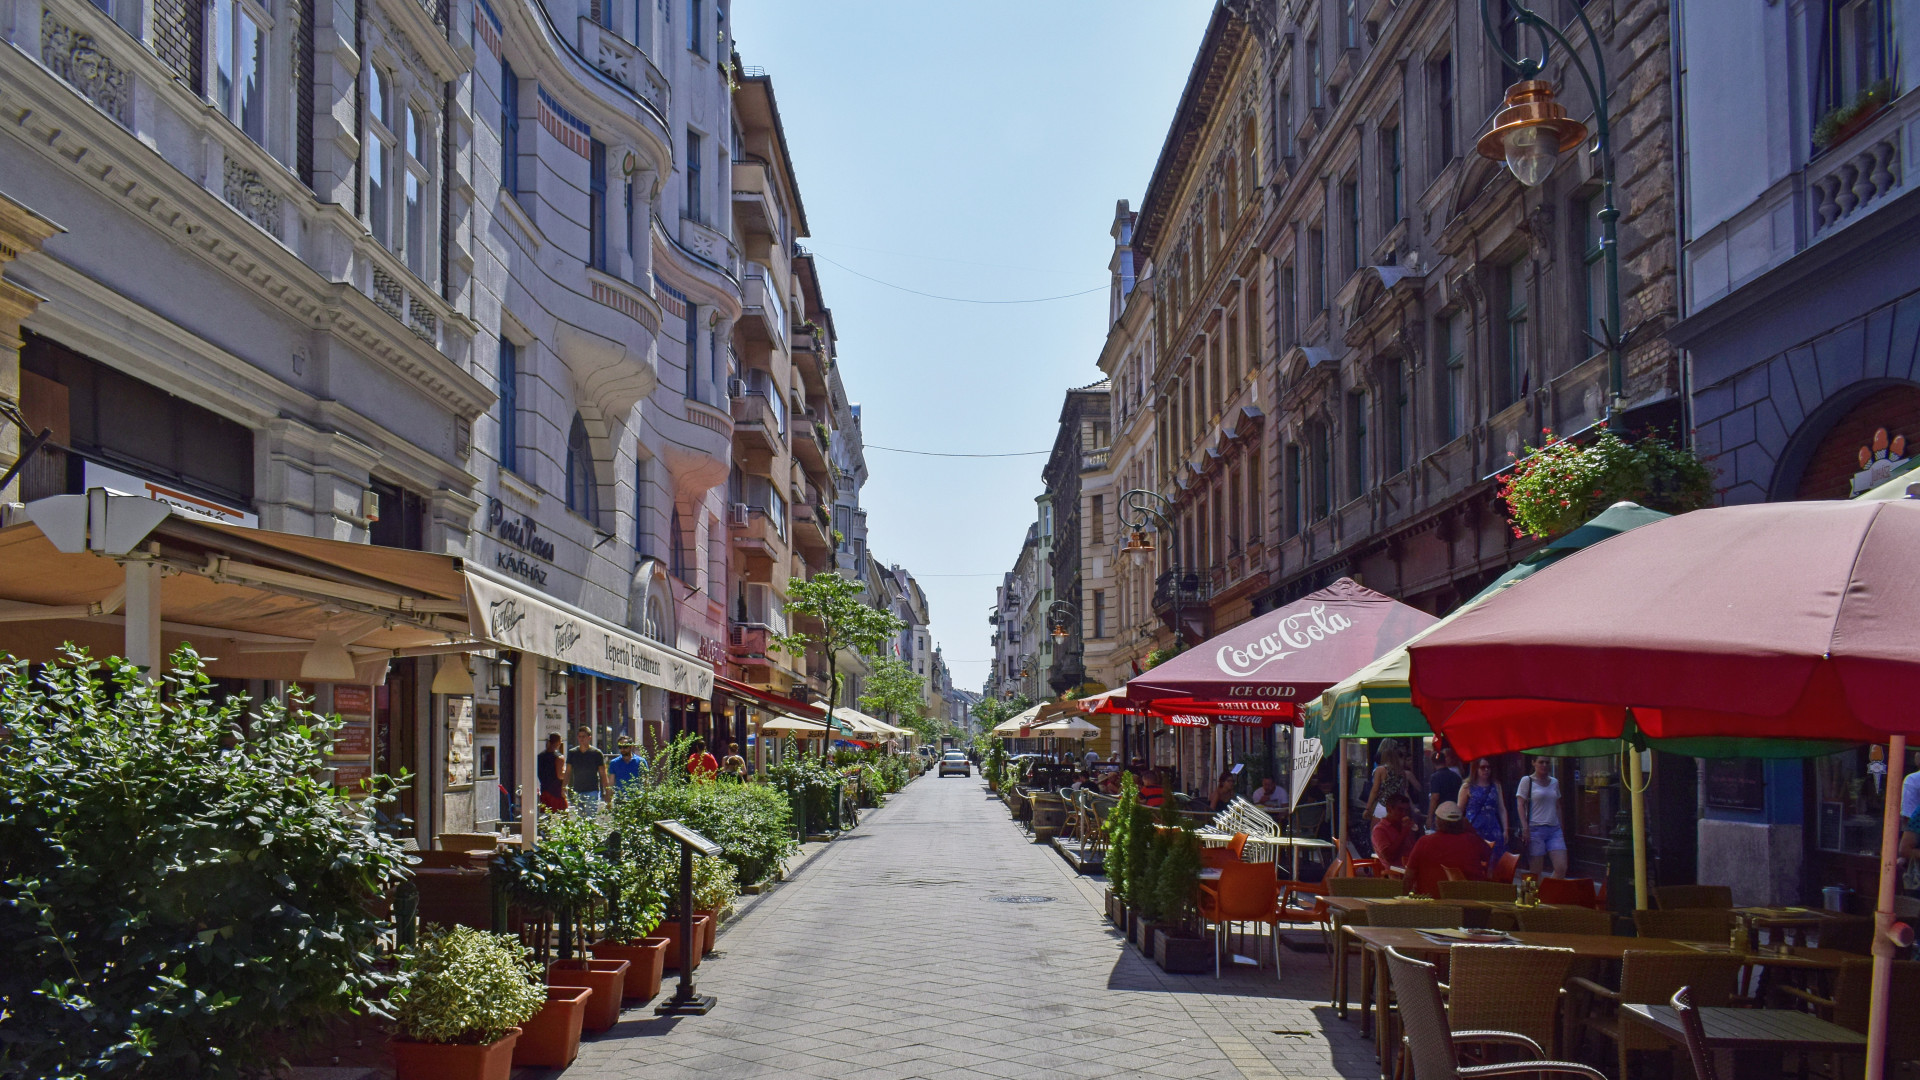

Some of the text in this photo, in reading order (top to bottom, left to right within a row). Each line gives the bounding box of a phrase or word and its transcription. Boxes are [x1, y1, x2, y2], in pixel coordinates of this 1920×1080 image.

[496, 552, 548, 586] KÁVÉHÁZ
[1216, 603, 1352, 677] Coca-Cola
[1229, 686, 1296, 697] ICE COLD
[1299, 738, 1314, 755] ICE
[1292, 752, 1319, 771] CREAM
